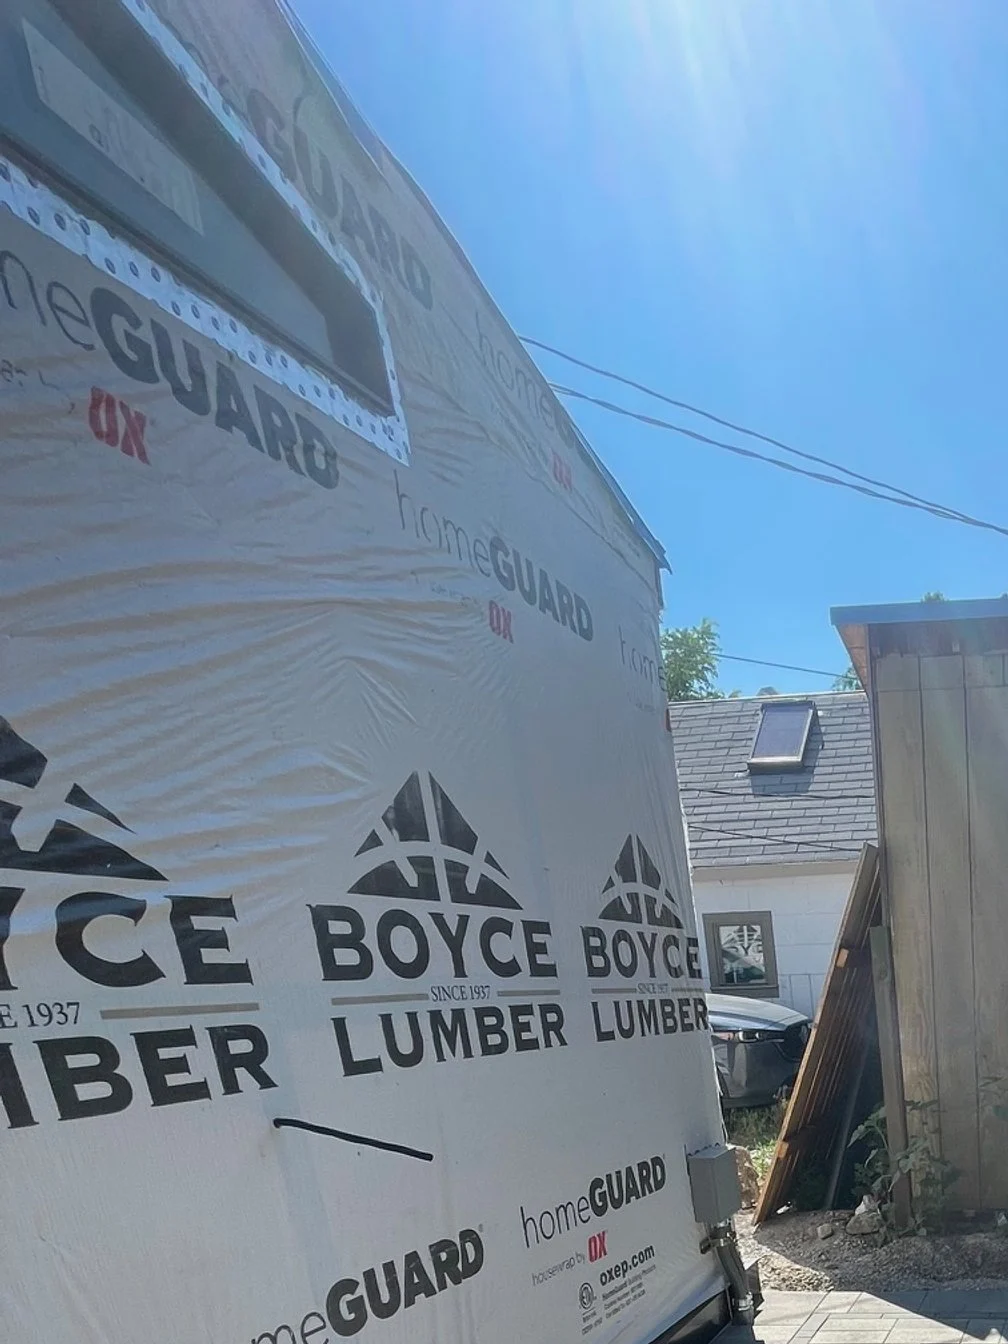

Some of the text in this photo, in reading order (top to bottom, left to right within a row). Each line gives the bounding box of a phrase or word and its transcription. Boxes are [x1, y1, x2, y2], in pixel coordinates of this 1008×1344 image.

[88, 386, 150, 466] OX
[394, 469, 593, 642] homeGUARD
[488, 600, 514, 644] OX
[306, 904, 558, 981] BOYCE
[580, 926, 702, 979] BOYCE
[23, 1002, 80, 1026] 1937
[431, 985, 491, 1001] SINCE 1937
[331, 1002, 568, 1077] LUMBER
[591, 998, 709, 1042] LUMBER
[520, 1156, 666, 1248] homeGUARD
[587, 1230, 608, 1263] OX
[600, 1246, 655, 1286] oxep.com
